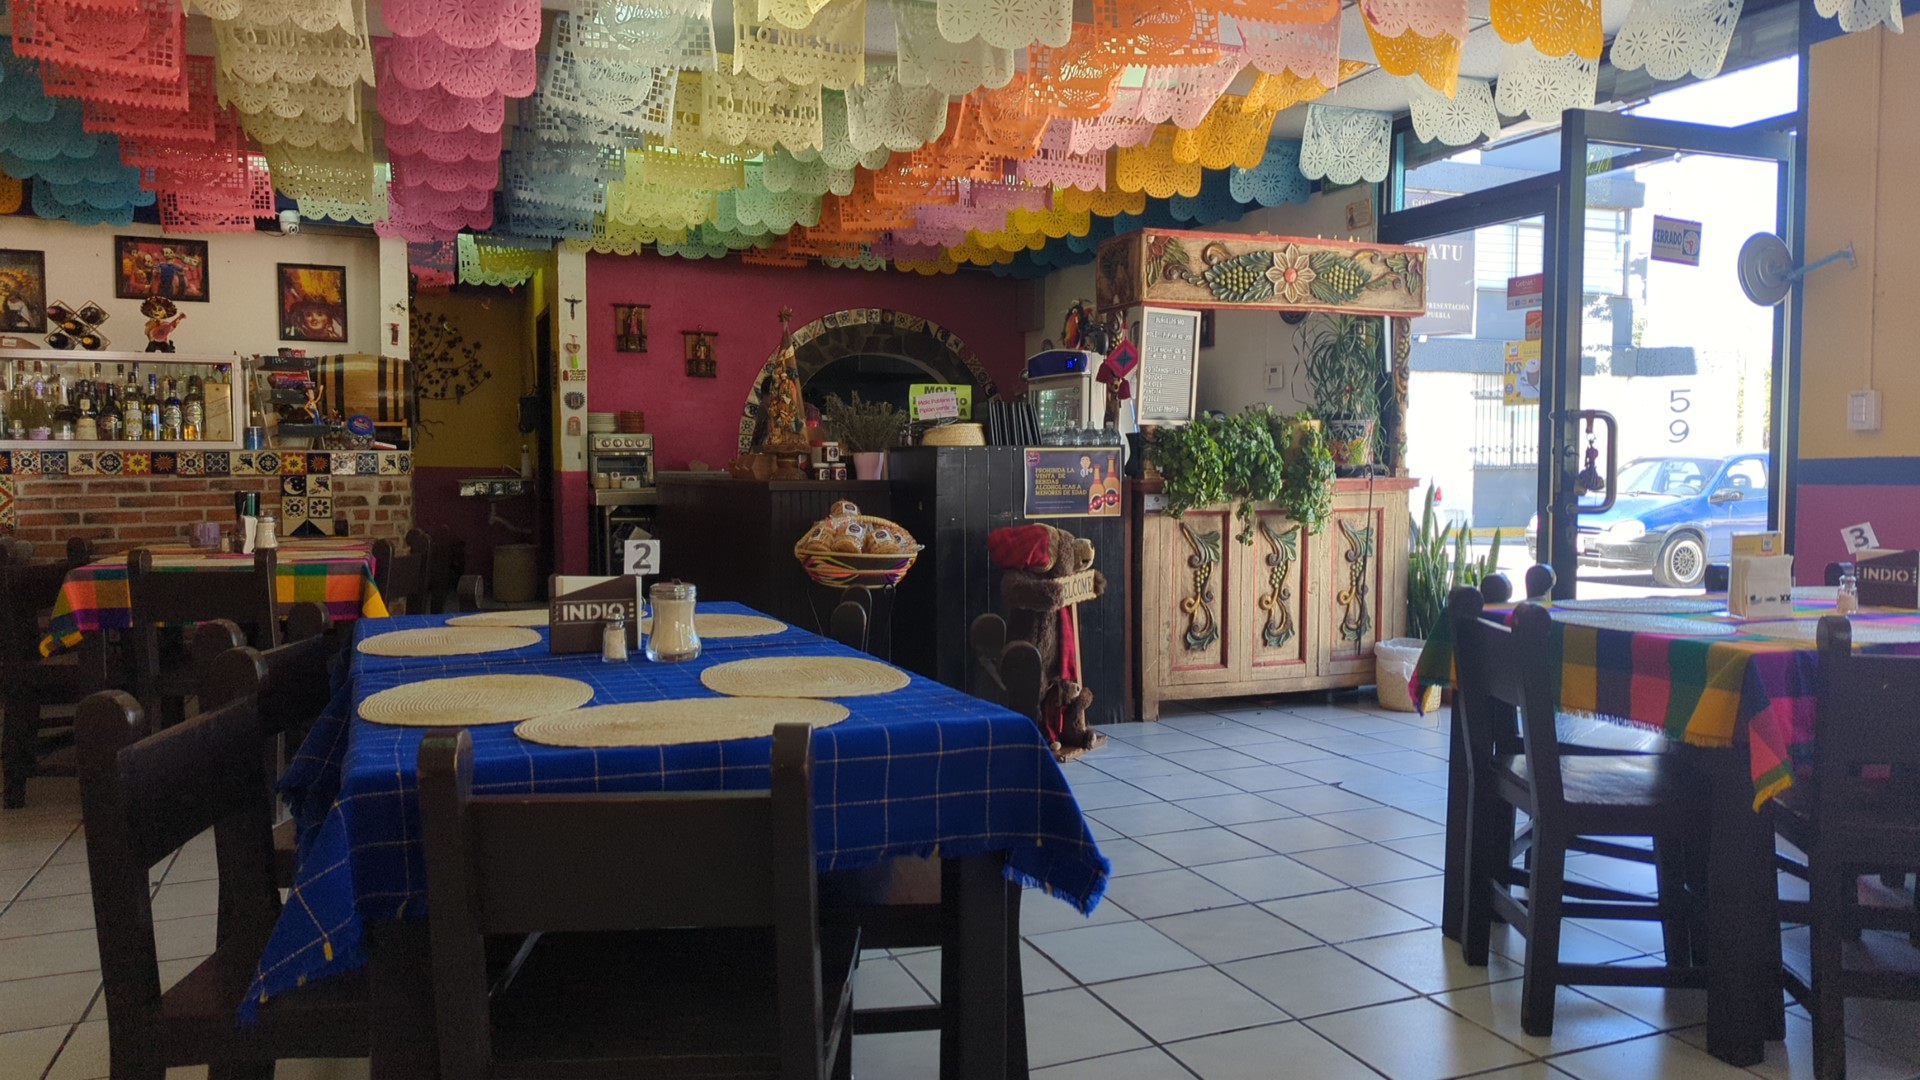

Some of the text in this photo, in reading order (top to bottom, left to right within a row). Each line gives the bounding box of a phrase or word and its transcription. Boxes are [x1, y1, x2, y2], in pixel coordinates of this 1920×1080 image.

[1849, 527, 1869, 548] 3
[632, 543, 652, 570] 2
[1863, 567, 1909, 582] INDIO
[1063, 576, 1092, 599] ELCOME
[562, 602, 625, 621] INDIO
